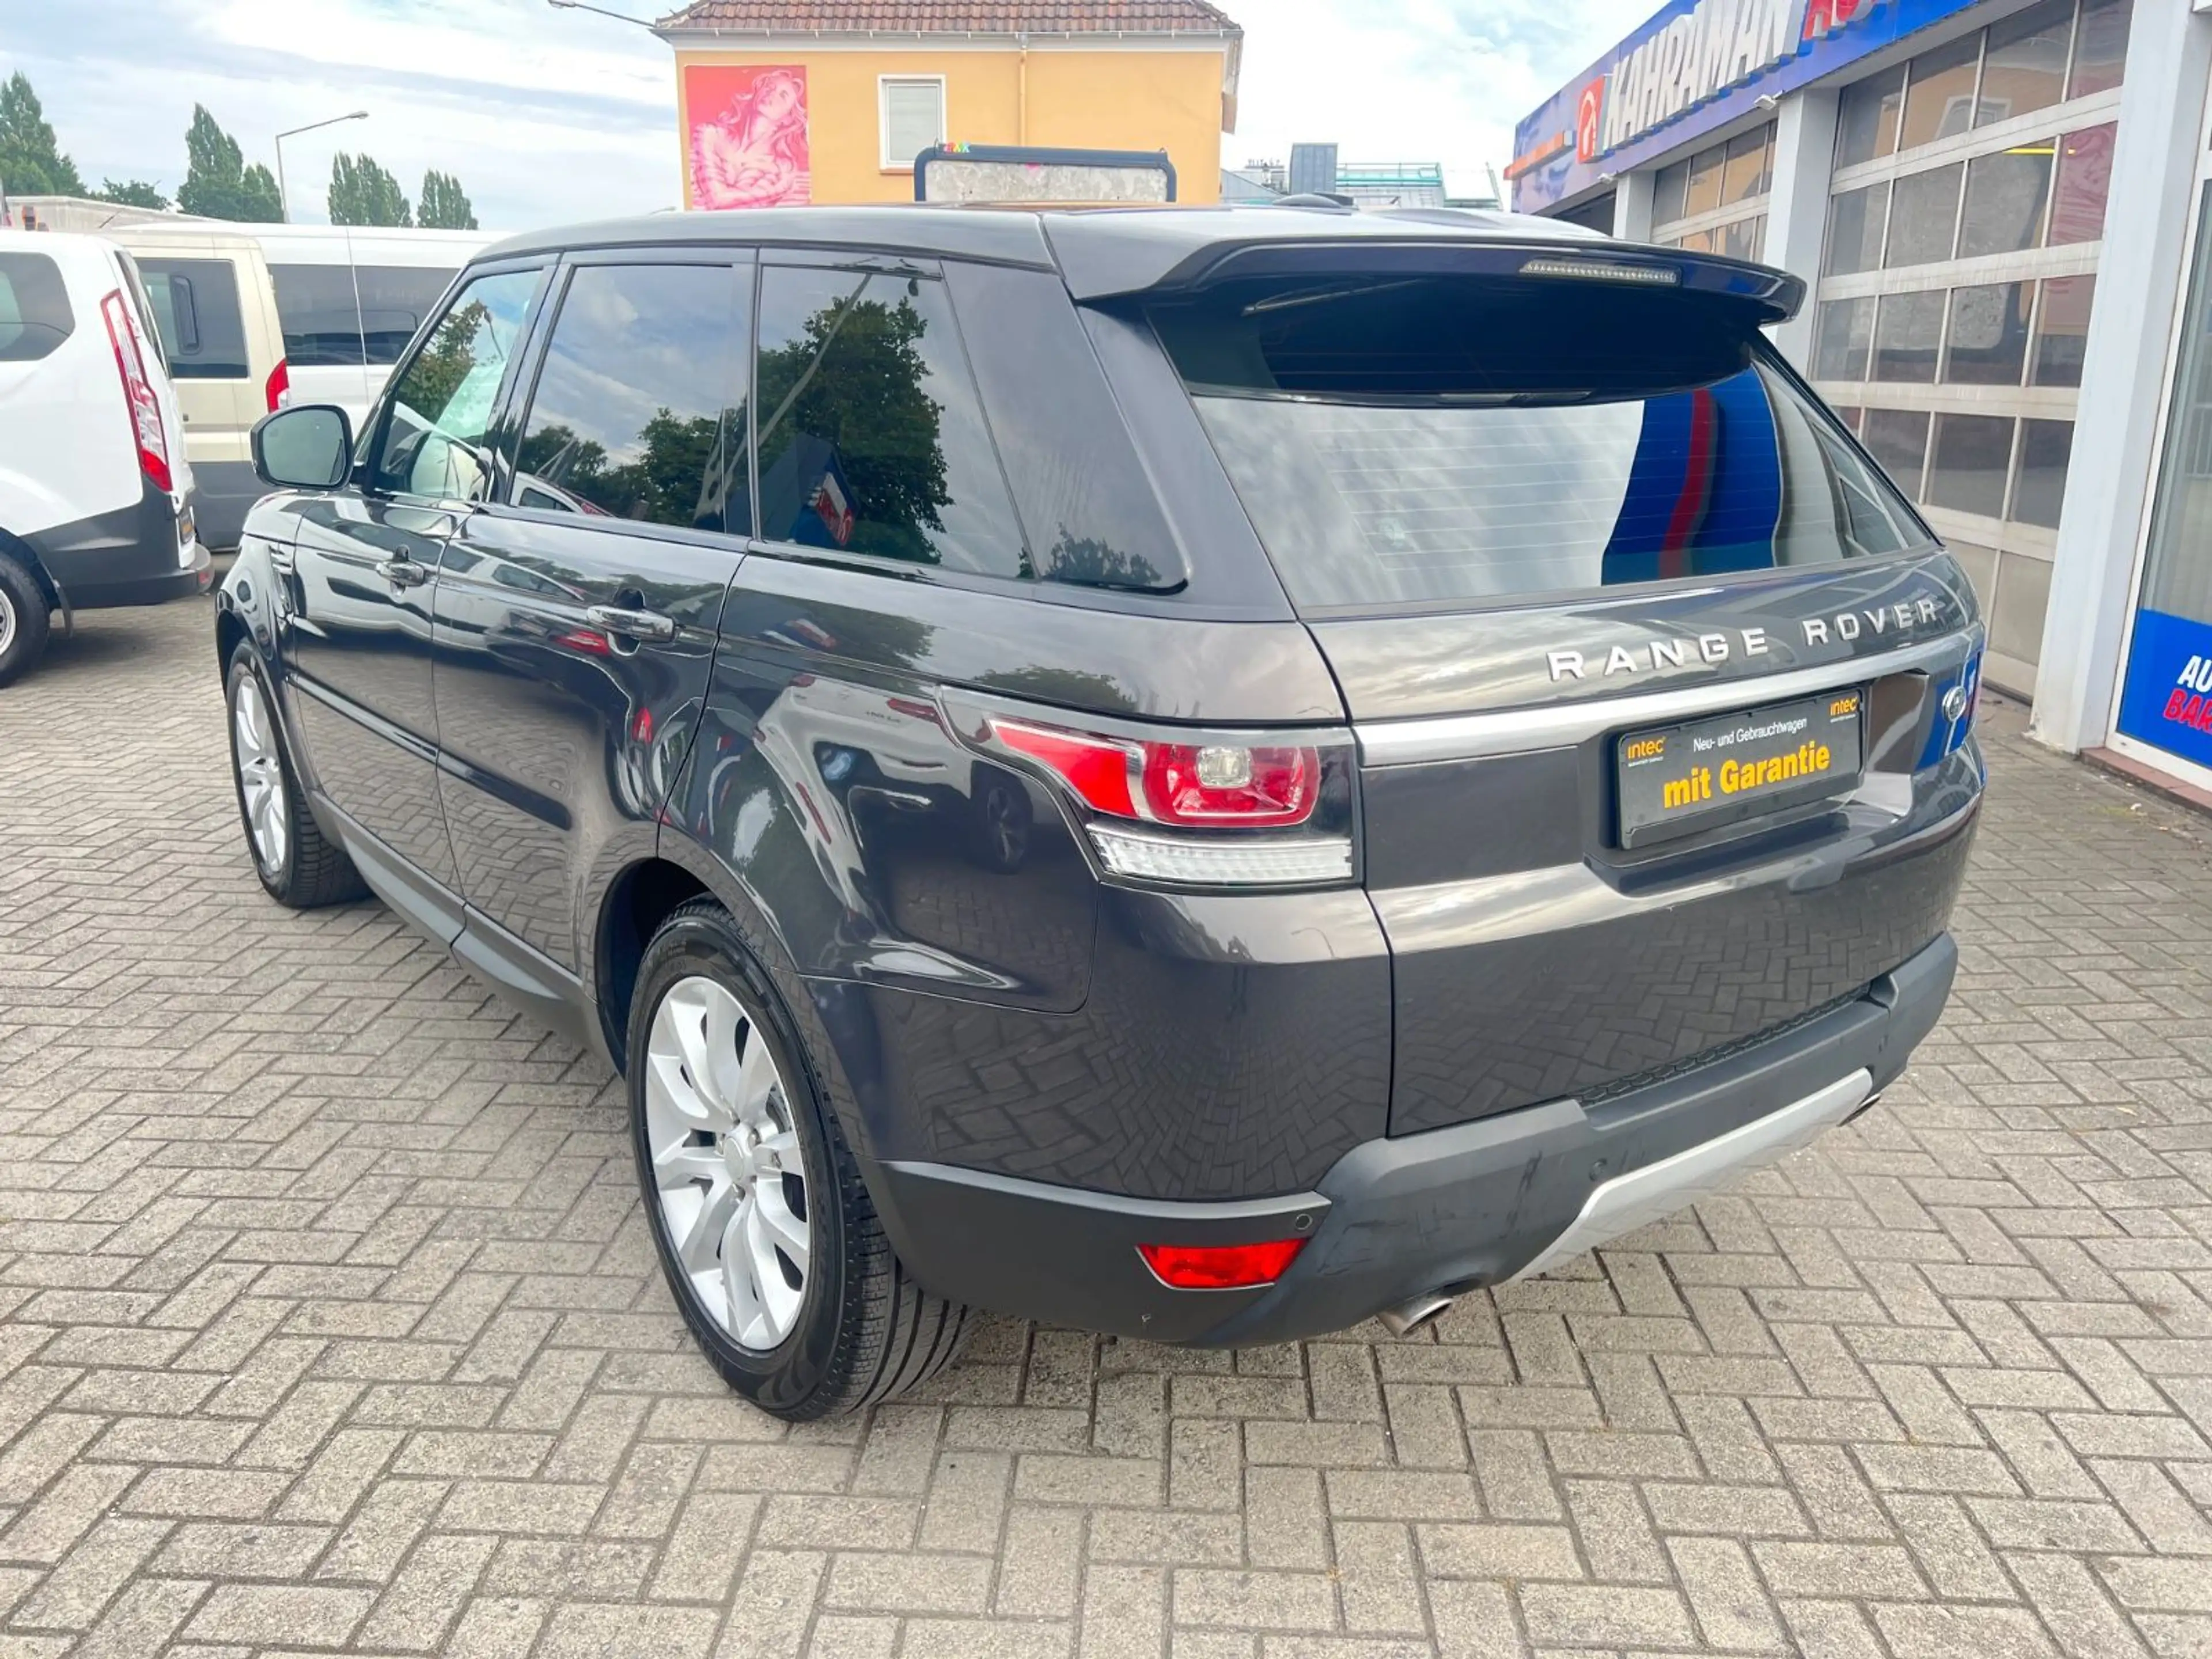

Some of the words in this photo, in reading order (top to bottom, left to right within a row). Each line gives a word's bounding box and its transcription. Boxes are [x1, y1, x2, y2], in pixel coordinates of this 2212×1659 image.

[1603, 0, 1798, 151] KAHRAMAN
[1547, 627, 1768, 681] RANGE
[1802, 598, 1940, 647] ROVER
[1628, 739, 1665, 759] intec
[1694, 738, 1715, 752] Neu-
[1717, 731, 1735, 747] und
[1736, 717, 1808, 743] Gebrauchtwagen
[1664, 767, 1711, 808] mit
[1719, 740, 1831, 794] Garantie
